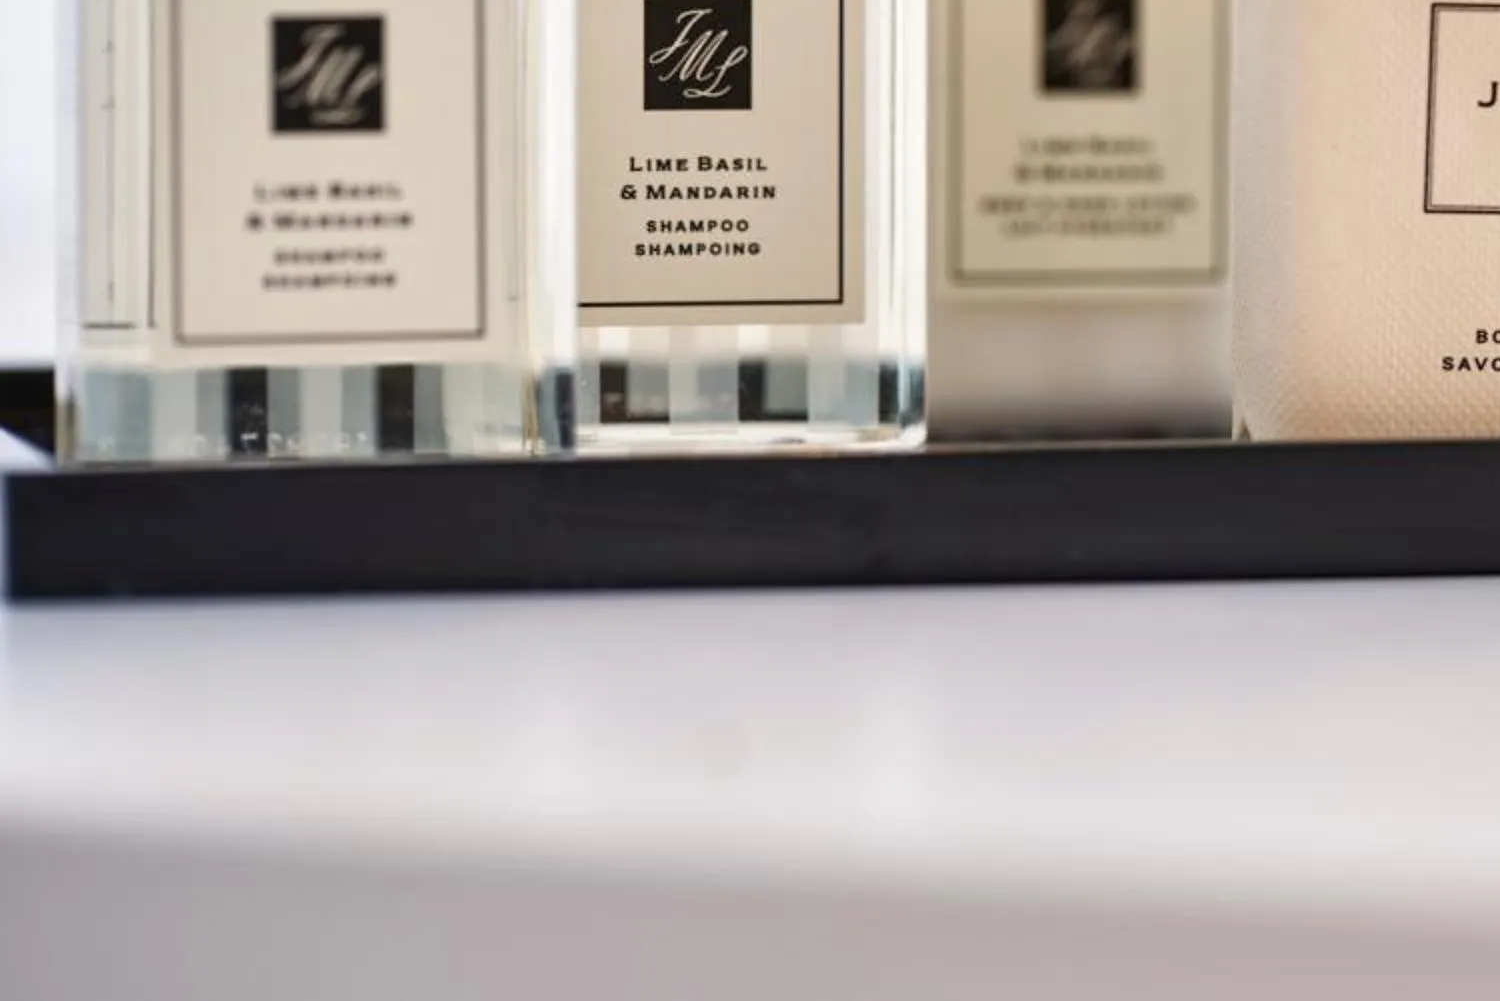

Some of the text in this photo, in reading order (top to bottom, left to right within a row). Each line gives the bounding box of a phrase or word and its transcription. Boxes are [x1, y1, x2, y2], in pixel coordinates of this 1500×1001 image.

[629, 155, 768, 173] LIME BASIL
[620, 184, 776, 200] & MANDARIN
[645, 218, 749, 234] SHAMPOO
[634, 242, 761, 257] SHAMPOING
